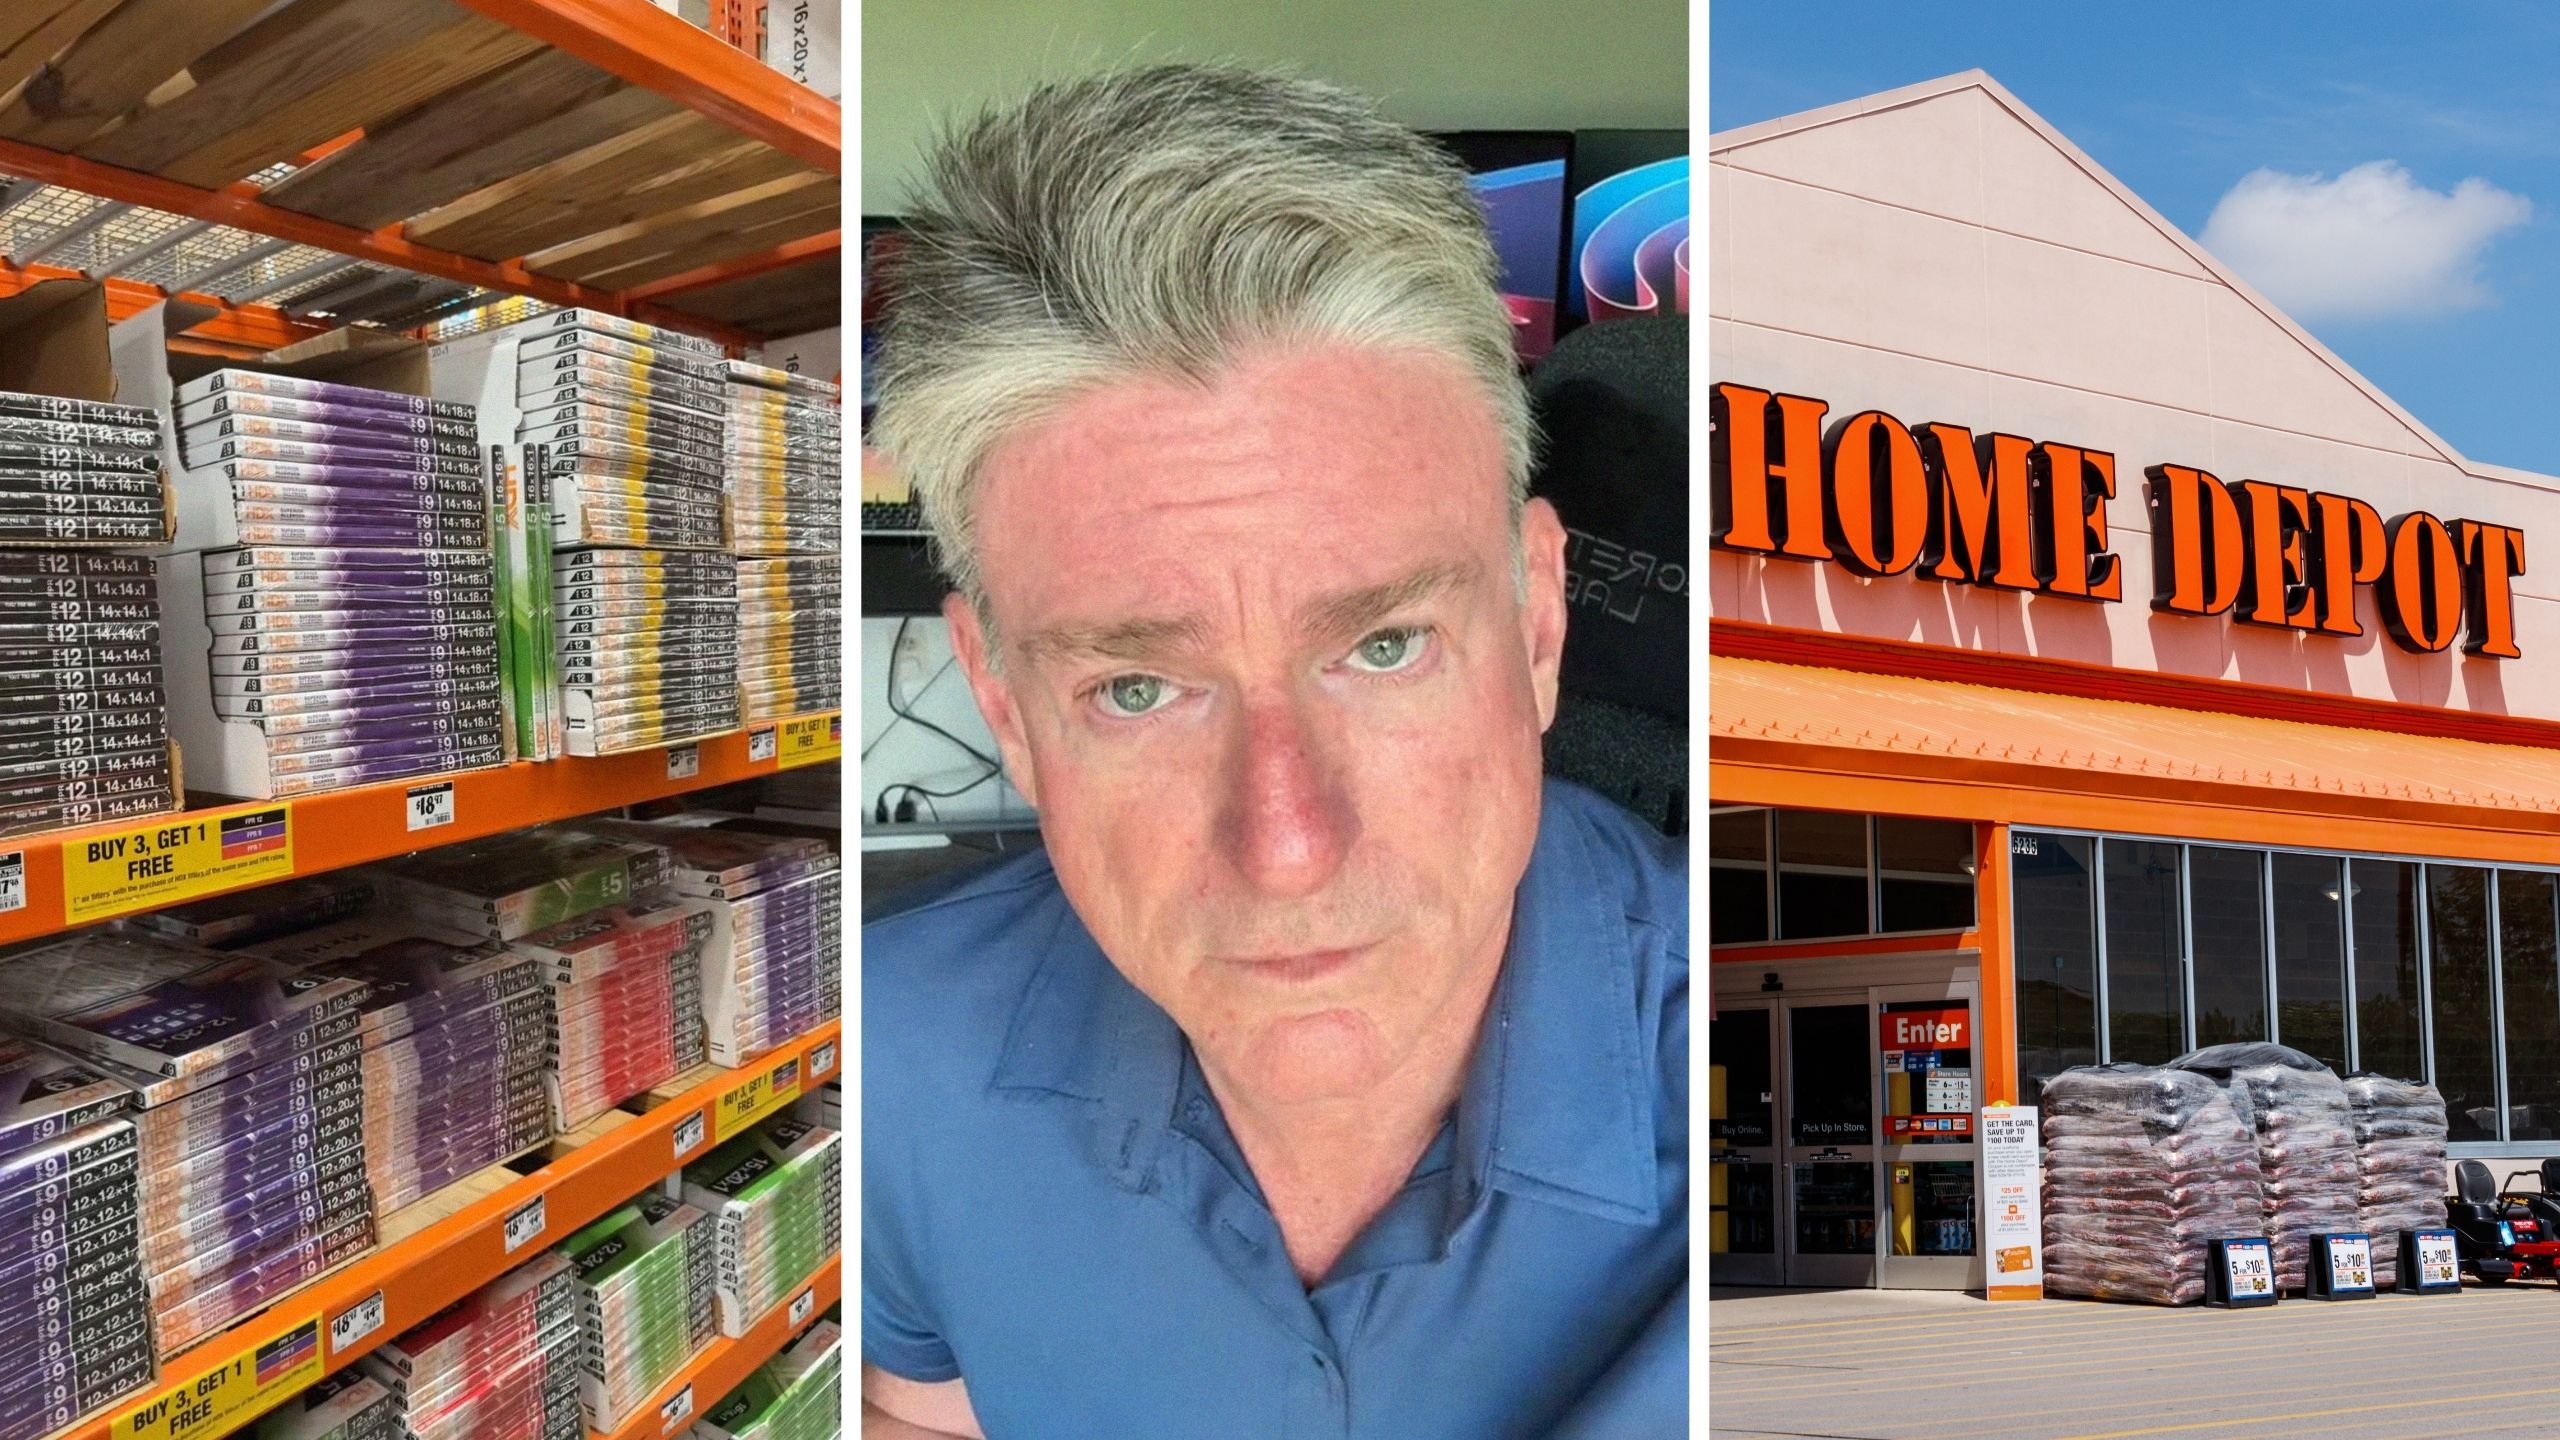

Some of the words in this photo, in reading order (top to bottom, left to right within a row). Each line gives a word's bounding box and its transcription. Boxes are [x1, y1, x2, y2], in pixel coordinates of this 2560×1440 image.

[51, 401, 72, 419] 12
[91, 407, 144, 425] 14x14x1
[415, 398, 424, 413] 9
[420, 438, 429, 452] 9
[49, 447, 71, 467] 12
[90, 454, 143, 469] 14x14x1
[49, 471, 72, 490] 12
[91, 477, 145, 491] 14x14x1
[527, 451, 535, 499] 16x16x1
[425, 495, 434, 510] 9
[1710, 381, 2123, 604] HOME
[2145, 463, 2526, 660] DEPOT
[434, 590, 442, 605] 9
[61, 648, 83, 667] 12
[100, 649, 150, 663] 14x14x1
[439, 718, 448, 733] 9
[786, 723, 799, 734] BUY
[808, 720, 820, 731] GET
[62, 737, 84, 756] 12
[101, 733, 151, 749] 14x14x1
[798, 736, 813, 747] FREE
[447, 755, 455, 770] 9
[70, 803, 92, 823] 12
[109, 797, 159, 814] 14x14x1
[87, 837, 127, 863] BUY
[134, 835, 151, 856] 3,
[158, 826, 191, 849] GET
[197, 824, 206, 841] 1
[128, 854, 174, 881] FREE
[128, 884, 138, 893] the
[139, 879, 166, 891] purchase
[315, 1005, 324, 1020] 9
[333, 988, 367, 1011] 12x20x1
[1896, 1018, 1962, 1044] Enter
[300, 1056, 309, 1071] 9
[321, 1038, 360, 1062] 12x20x1
[724, 1091, 738, 1106] BUY
[749, 1078, 762, 1093] GET
[737, 1096, 755, 1114] FREE
[42, 1119, 55, 1138] 9
[72, 1097, 125, 1125] 12x12x1
[1803, 1124, 1819, 1132] Pick
[1822, 1124, 1833, 1134] Up
[1834, 1124, 1841, 1132] In
[1843, 1123, 1867, 1132] Store.
[1722, 1125, 1736, 1136] Buy
[1738, 1125, 1764, 1134] Online.
[45, 1158, 58, 1177] 9
[75, 1132, 131, 1163] 12x12x1
[299, 1172, 309, 1188] 9
[321, 1151, 361, 1177] 12x20x1
[41, 1229, 54, 1249] 9
[71, 1202, 127, 1234] 12x12x1
[305, 1244, 314, 1258] 9
[326, 1219, 366, 1246] 12x20x1
[2232, 1261, 2238, 1275] 5
[2246, 1260, 2260, 1273] $10
[2334, 1255, 2339, 1268] 5
[2347, 1254, 2360, 1267] $10
[2423, 1251, 2428, 1264] 5
[2435, 1250, 2447, 1263] $10
[48, 1341, 61, 1360] 9
[78, 1308, 134, 1344] 12x12x1
[55, 1407, 68, 1425] 9
[85, 1371, 140, 1408] 12x12x1
[133, 1396, 170, 1432] BUY
[175, 1390, 191, 1410] 3,
[196, 1368, 227, 1395] GET
[235, 1360, 242, 1377] 1
[169, 1398, 212, 1436] FREE
